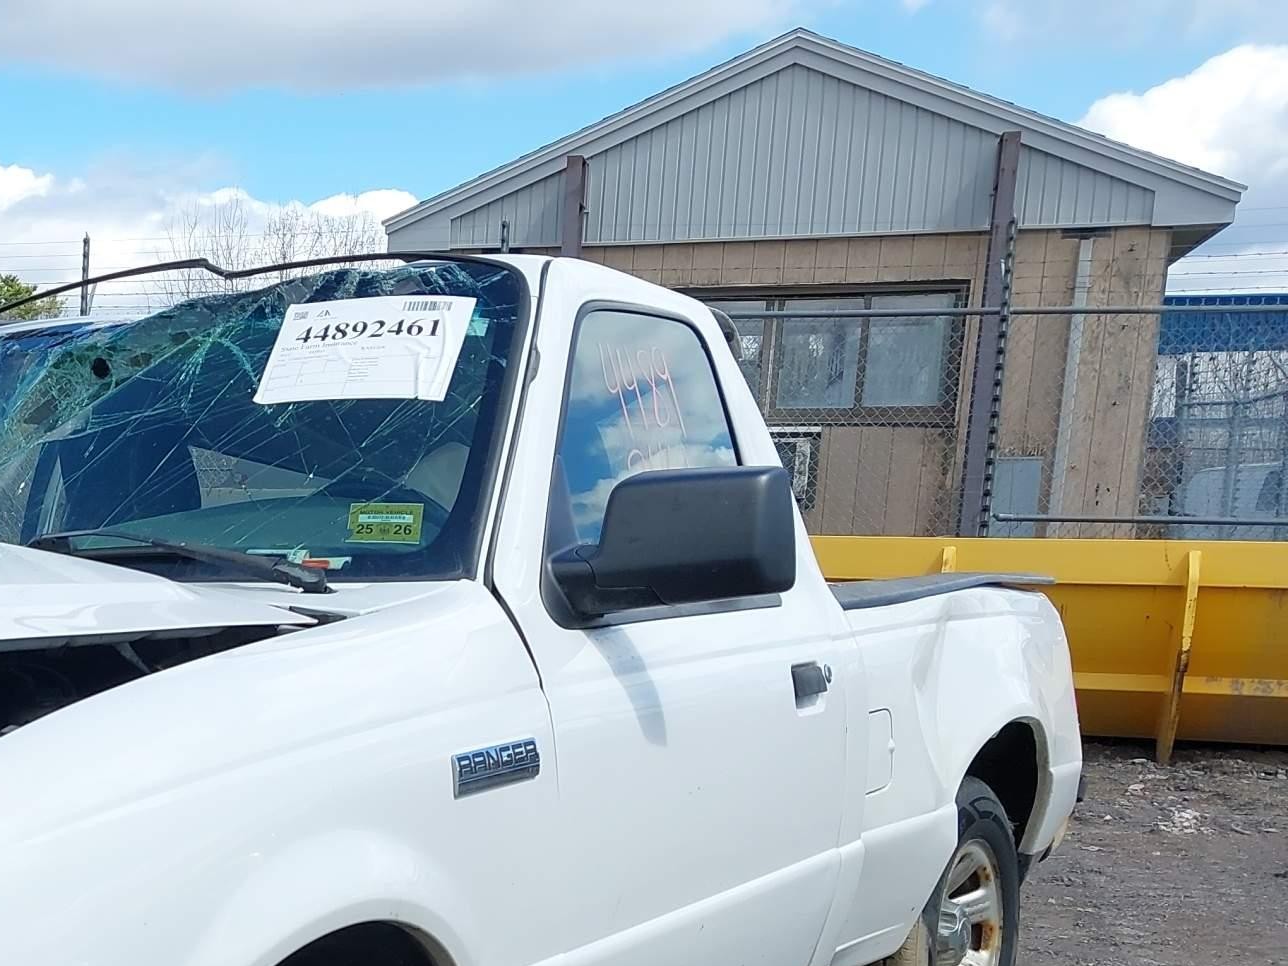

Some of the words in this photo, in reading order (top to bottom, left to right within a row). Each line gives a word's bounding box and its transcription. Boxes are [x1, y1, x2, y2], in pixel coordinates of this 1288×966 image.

[295, 319, 441, 343] 44892461
[356, 523, 374, 535] 25
[393, 524, 412, 536] 26
[456, 739, 539, 780] RANGER
